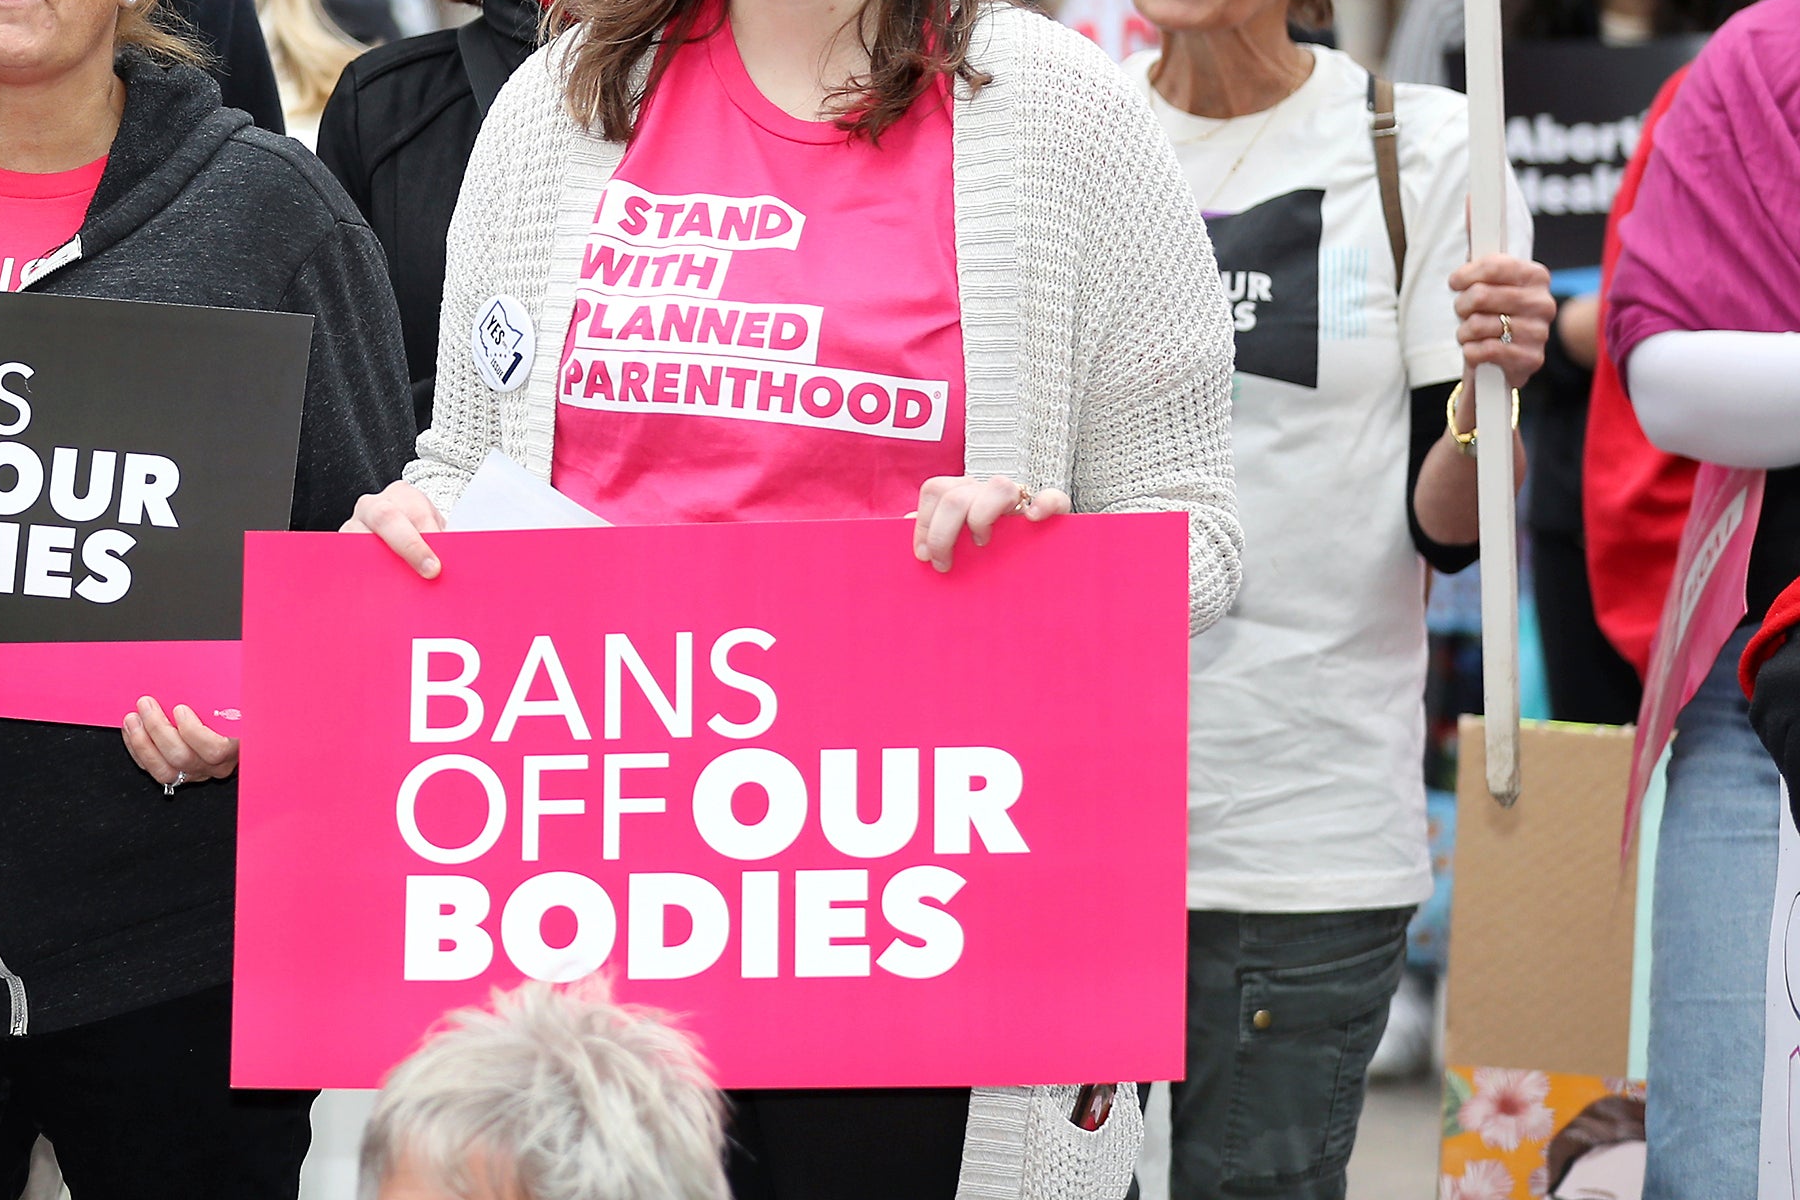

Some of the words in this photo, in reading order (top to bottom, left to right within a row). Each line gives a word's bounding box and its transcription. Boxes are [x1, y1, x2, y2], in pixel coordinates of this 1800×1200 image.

[1504, 112, 1646, 165] Abort
[617, 195, 794, 242] STAND
[580, 243, 720, 290] WITH
[1220, 270, 1273, 302] UR
[486, 314, 505, 346] YES
[501, 351, 523, 385] 1
[563, 358, 934, 429] PARENTHOOD
[408, 626, 779, 744] BANS
[395, 752, 671, 865] OFF
[691, 745, 1032, 861] OUR
[402, 864, 969, 984] BODIES
